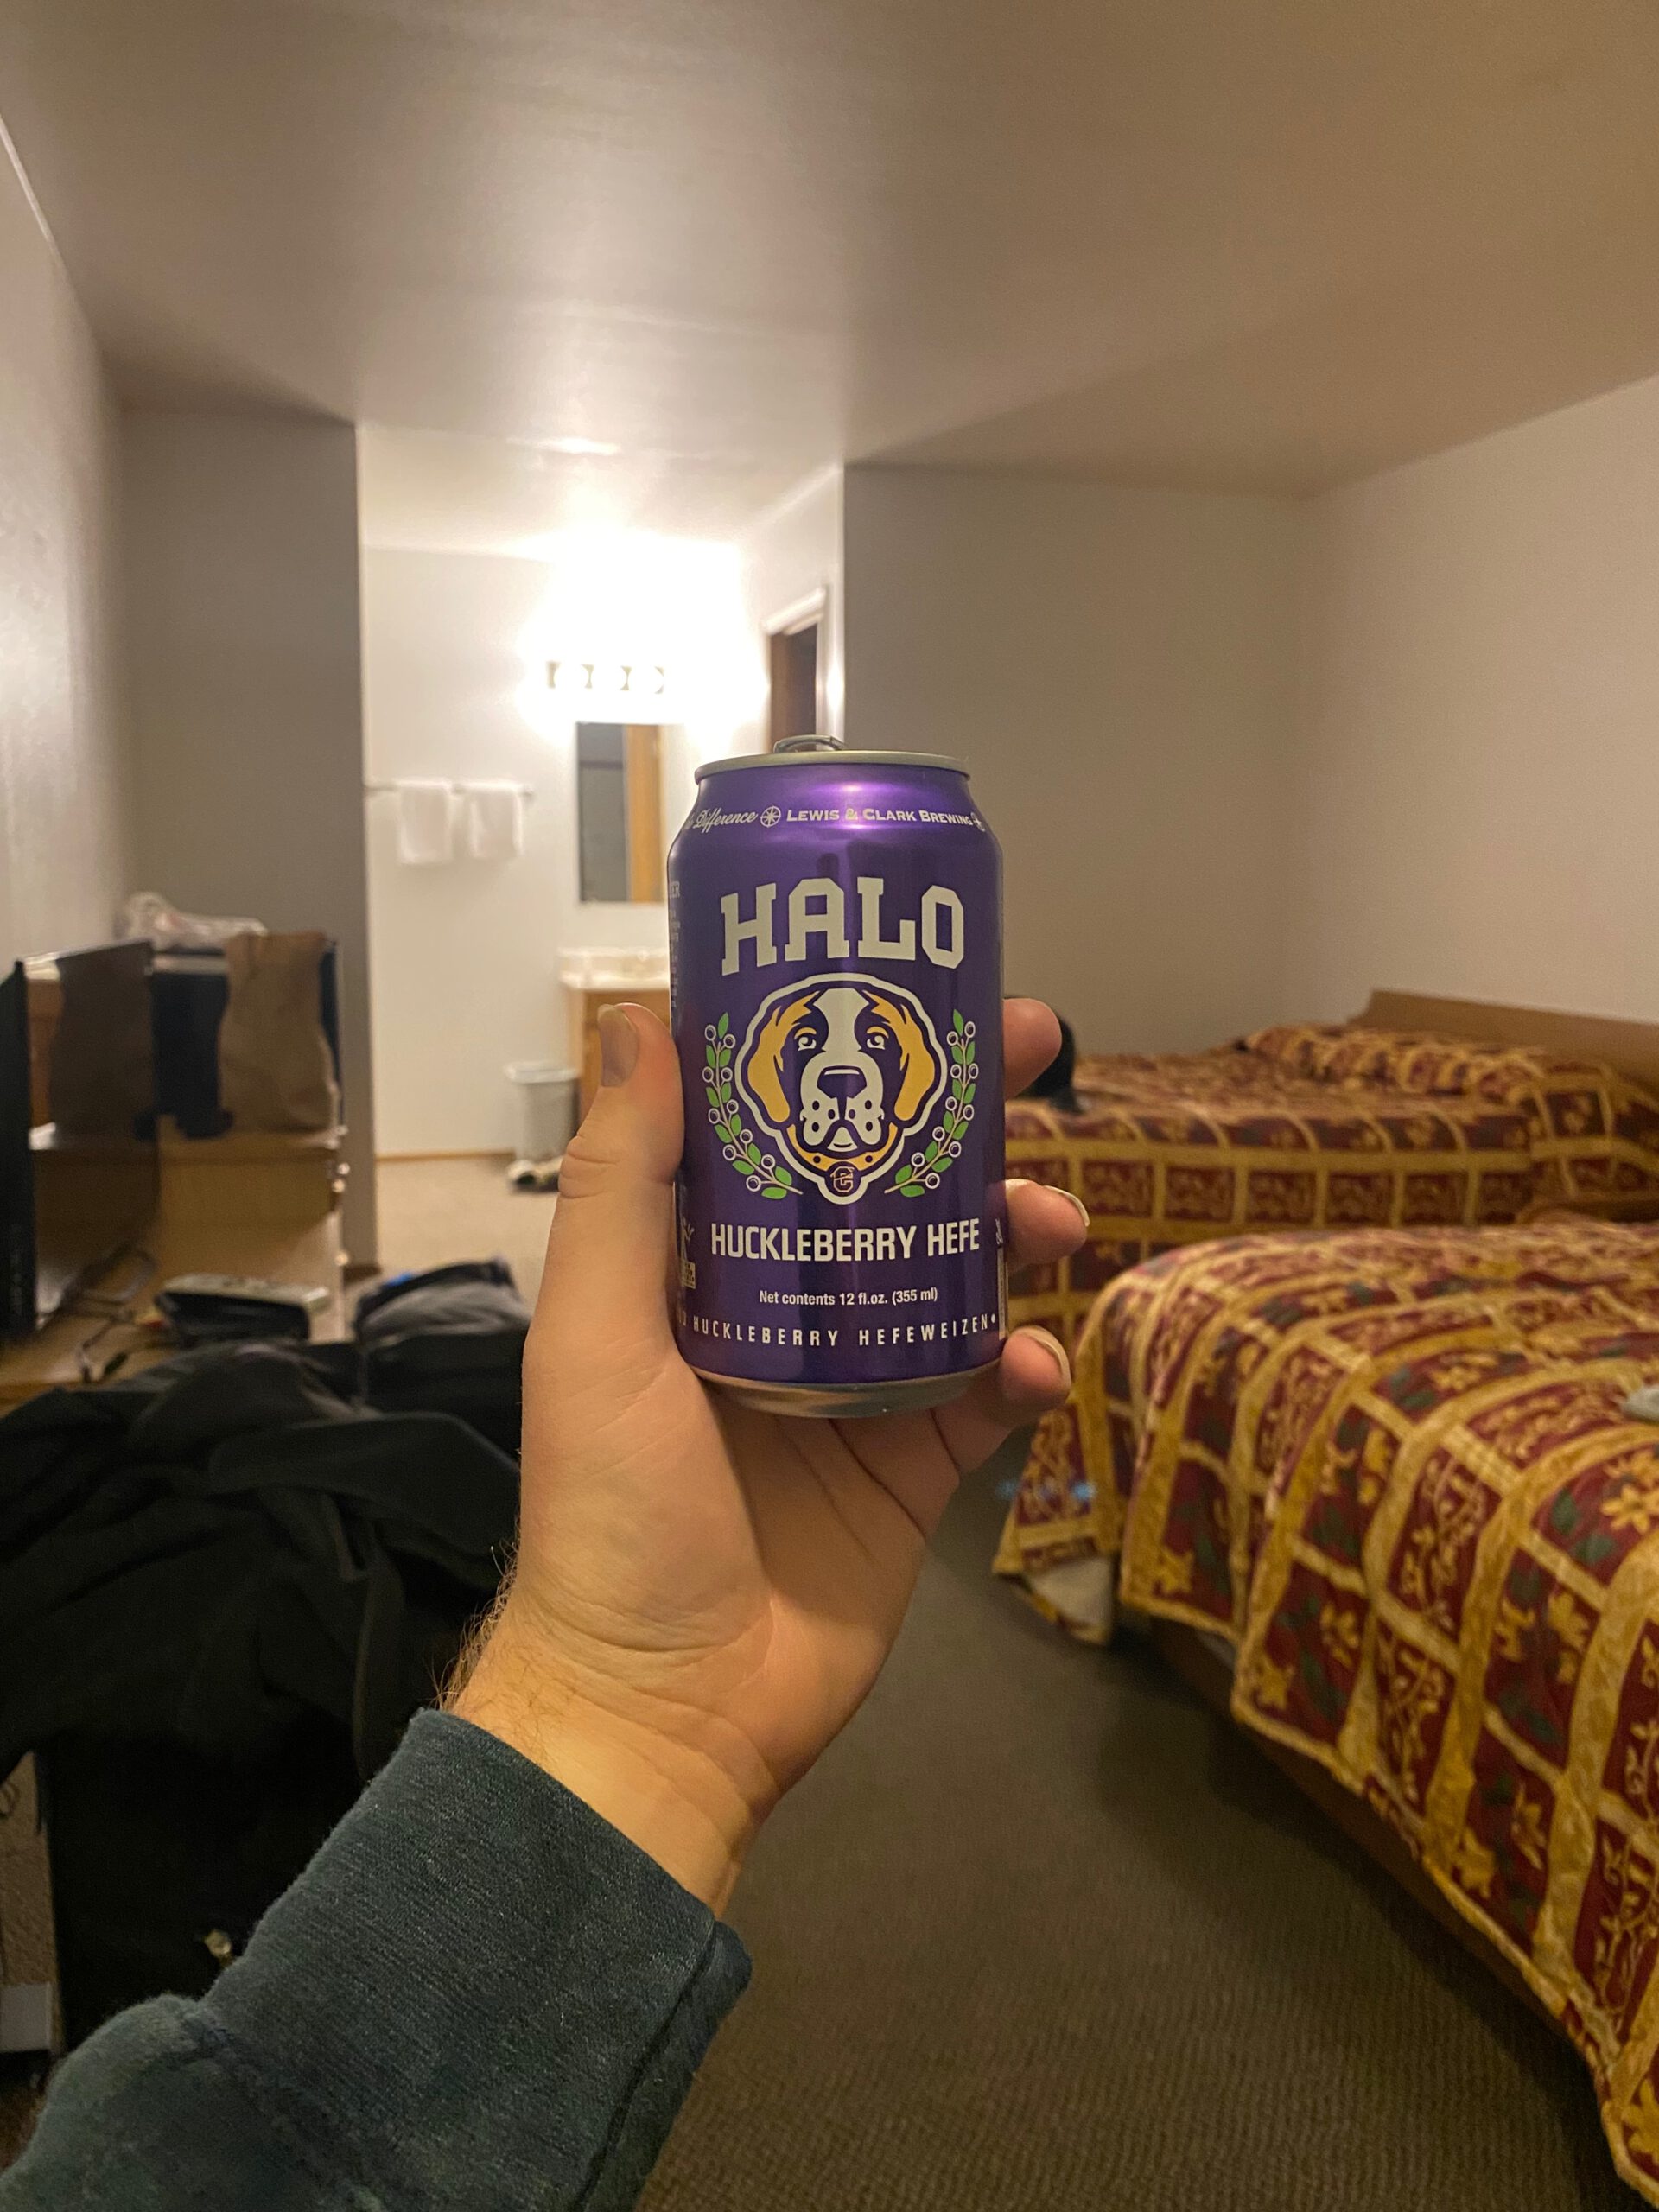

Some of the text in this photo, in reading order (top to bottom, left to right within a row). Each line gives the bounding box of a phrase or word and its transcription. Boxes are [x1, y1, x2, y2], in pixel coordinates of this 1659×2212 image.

[692, 807, 759, 834] Difference
[786, 808, 974, 826] LEWIS & CLARK BREWING
[721, 876, 964, 976] HALO
[711, 1223, 917, 1262] HUCKLEBERRY
[927, 1218, 981, 1257] HEFE
[759, 1290, 779, 1305] Net
[782, 1291, 836, 1306] contents
[839, 1293, 855, 1306] 12
[892, 1289, 918, 1306] (355
[920, 1287, 938, 1303] ml)
[693, 1318, 838, 1347] HUCKLEBERRY
